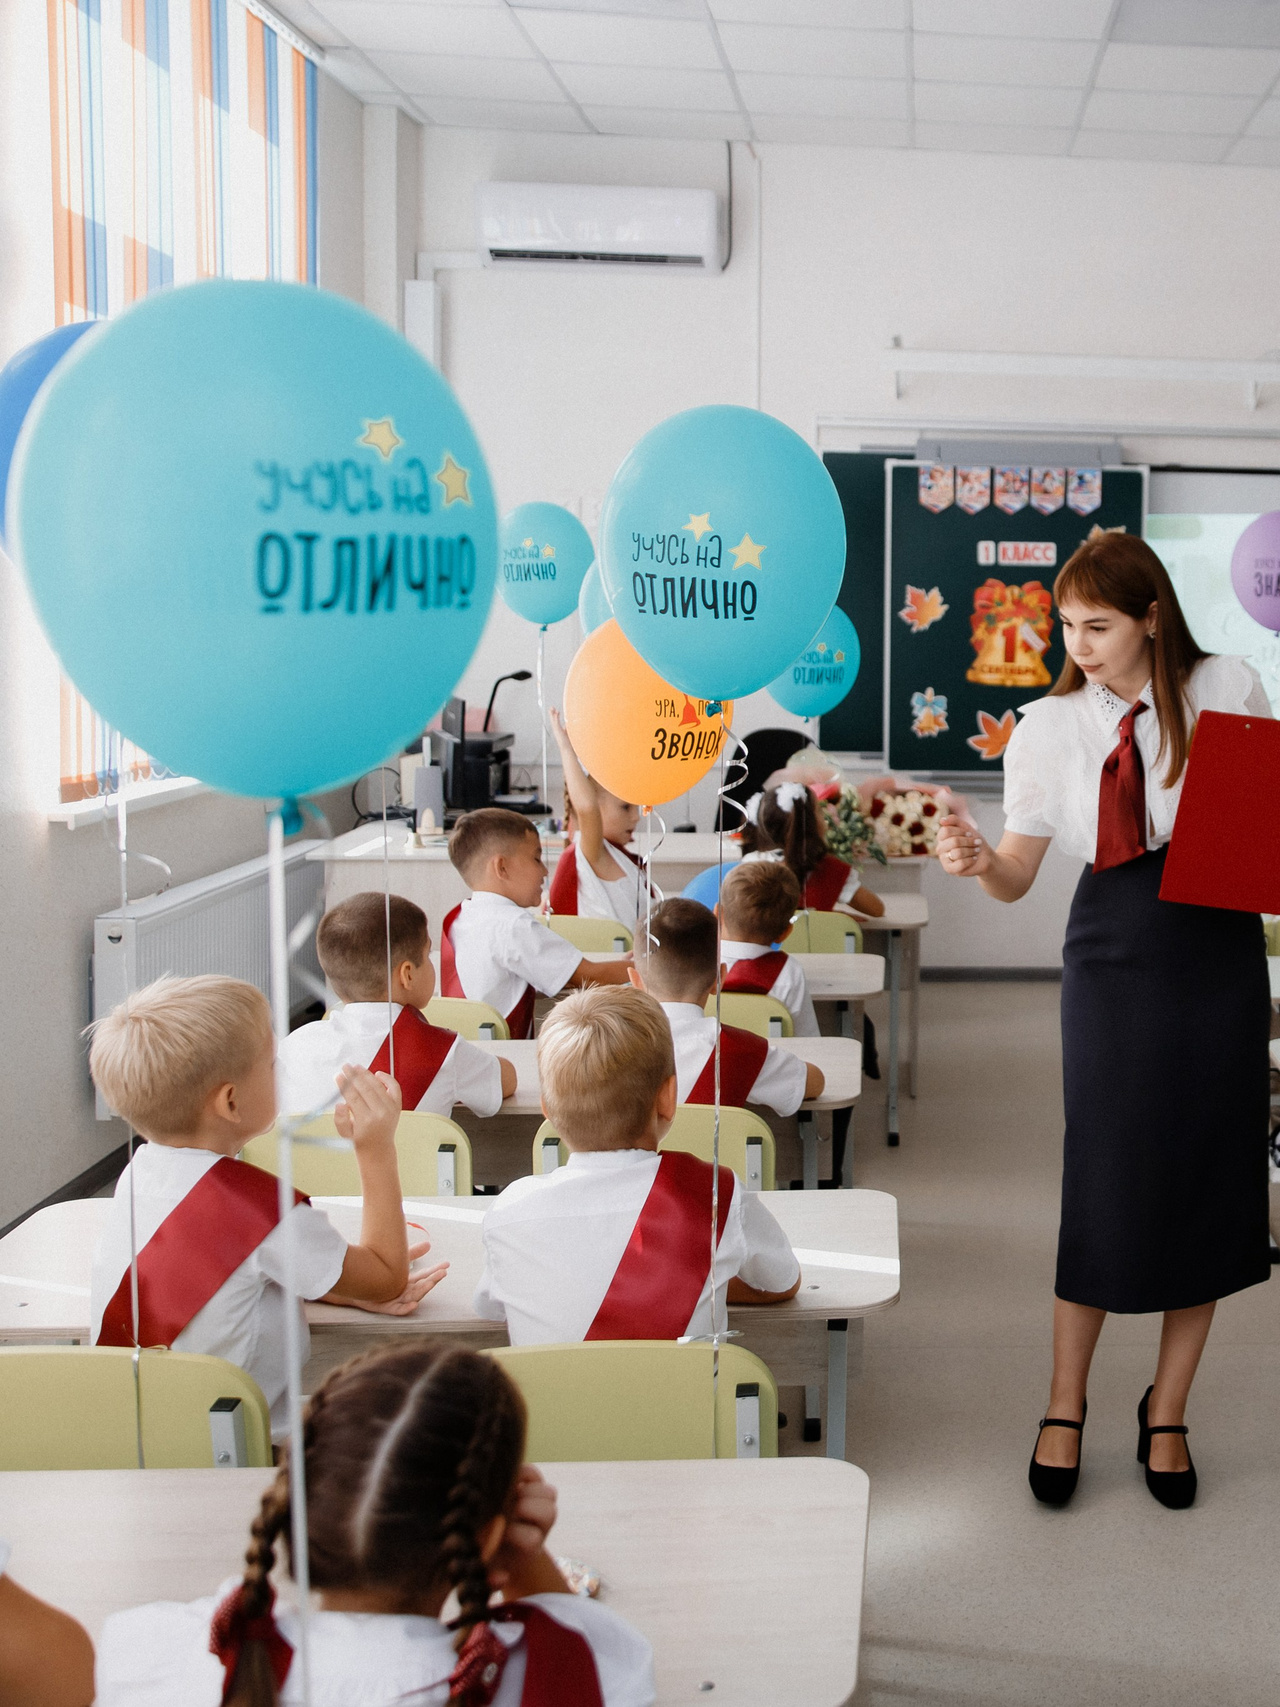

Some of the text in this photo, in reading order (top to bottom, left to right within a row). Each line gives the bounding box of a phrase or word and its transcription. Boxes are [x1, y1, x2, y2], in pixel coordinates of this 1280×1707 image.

[631, 532, 690, 566] УЧУСЬ
[1001, 544, 1054, 562] КЛАСС
[256, 530, 477, 614] ОТЛИЧНО
[503, 561, 557, 582] ОТЛИЧНО
[632, 571, 758, 621] ОТЛИЧНО
[1002, 624, 1017, 664] 1
[793, 666, 845, 685] ОТЛИЧНО
[655, 698, 680, 718] УРА,
